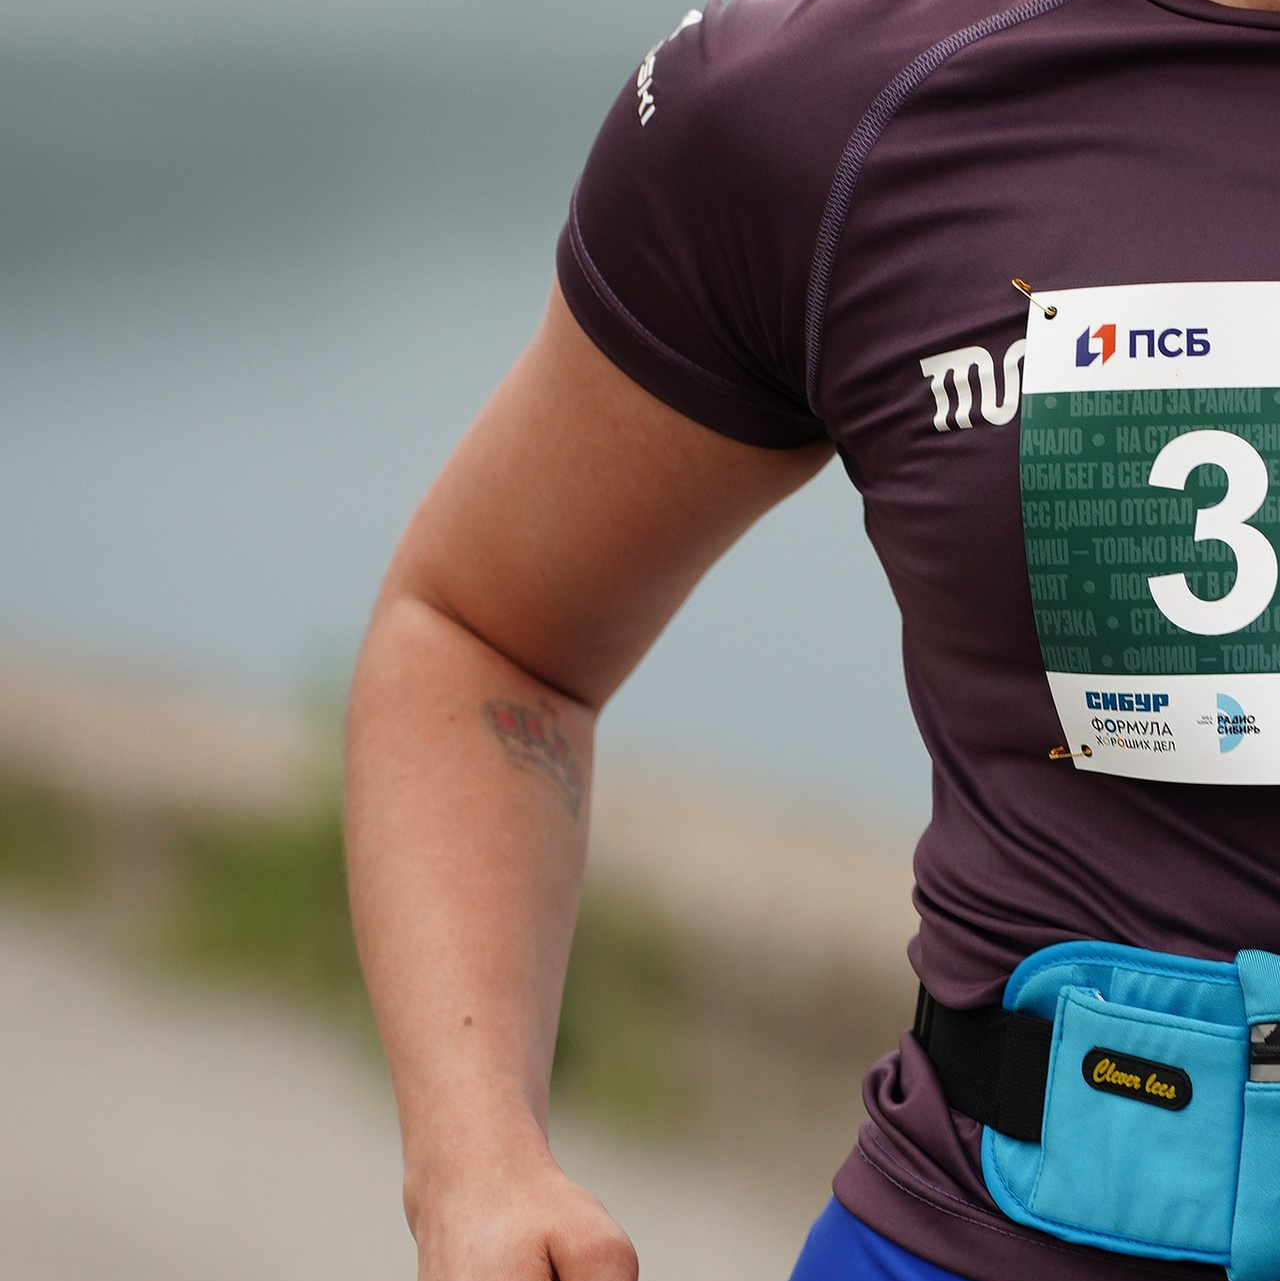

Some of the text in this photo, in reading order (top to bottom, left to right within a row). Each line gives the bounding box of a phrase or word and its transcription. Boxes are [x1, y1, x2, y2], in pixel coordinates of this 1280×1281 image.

[1129, 328, 1211, 358] ПСБ
[1020, 427, 1083, 456] АЧАЛО
[1116, 426, 1143, 454] НА
[1065, 461, 1098, 489] БЕГ
[1101, 461, 1114, 488] В
[1054, 499, 1117, 532] ДАВНО
[1120, 497, 1194, 527] ОТСТАЛ
[1092, 535, 1168, 565] ТОЛЬКО
[1170, 535, 1236, 563] НАЧАЛ
[1122, 644, 1197, 674] ФИНИШ
[1085, 691, 1169, 712] СИБУР
[1091, 717, 1173, 736] ФОРМУЛА
[1217, 715, 1256, 725] РАДИО
[1217, 725, 1261, 735] СИБИРЬ
[1095, 734, 1176, 753] ХОРОШИХ ДЕЛ
